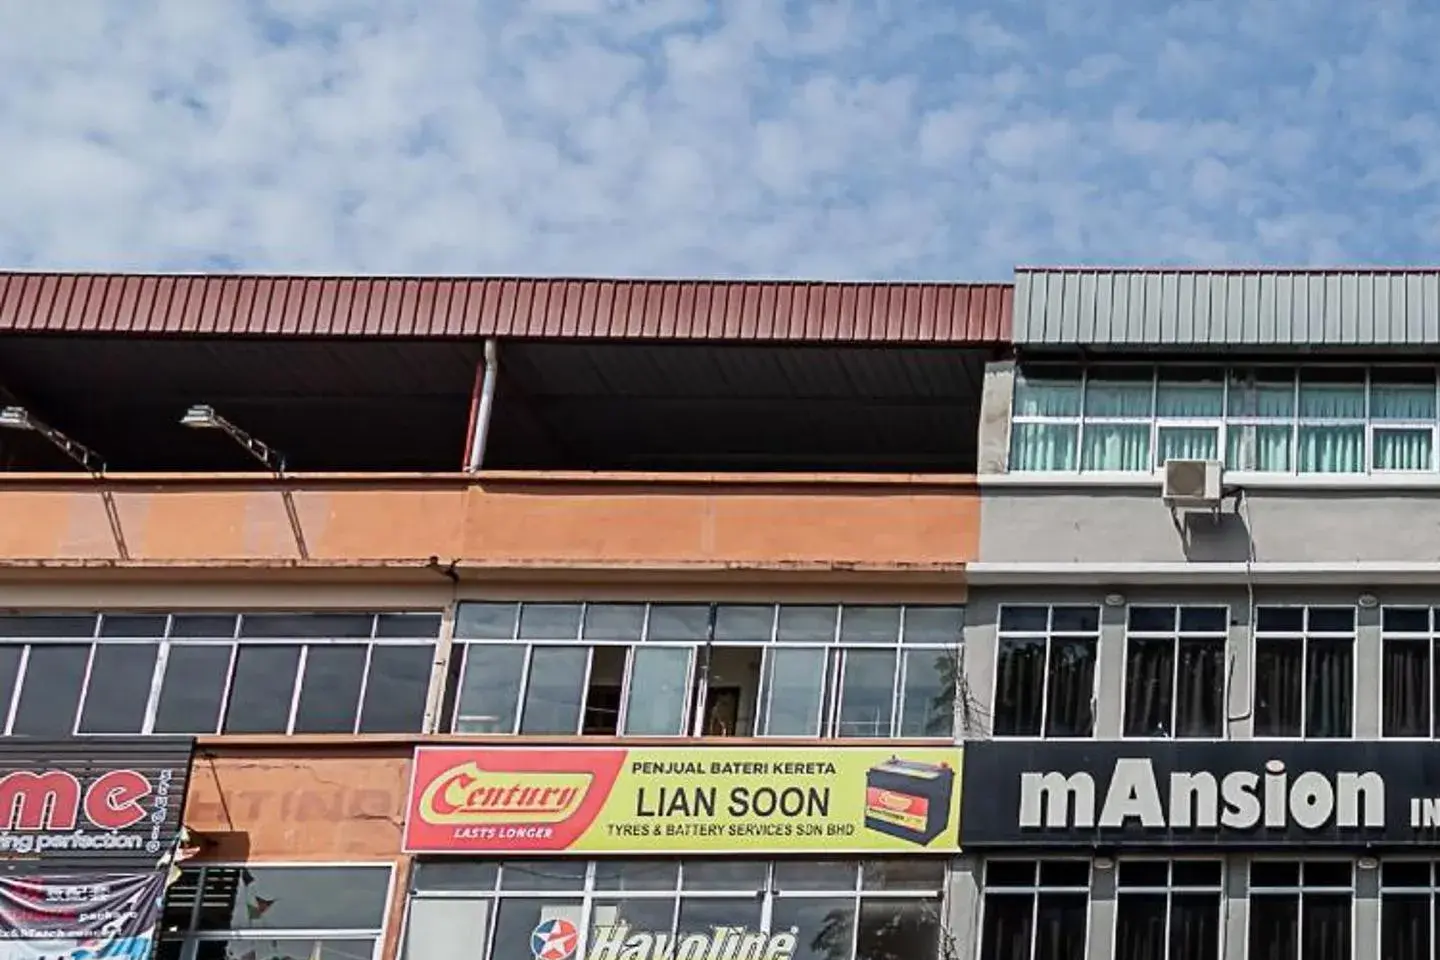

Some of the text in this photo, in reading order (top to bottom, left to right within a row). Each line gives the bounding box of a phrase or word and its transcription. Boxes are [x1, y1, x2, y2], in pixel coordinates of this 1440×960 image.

[632, 762, 836, 775] PENJUAL BATERI KERETA
[431, 772, 579, 815] Century
[636, 787, 830, 817] LIAN SOON
[1018, 758, 1385, 828] mAnsion
[454, 827, 553, 839] LASTS LONGER
[608, 824, 855, 836] TYRES & BATTERY SERVICES SDN BHD
